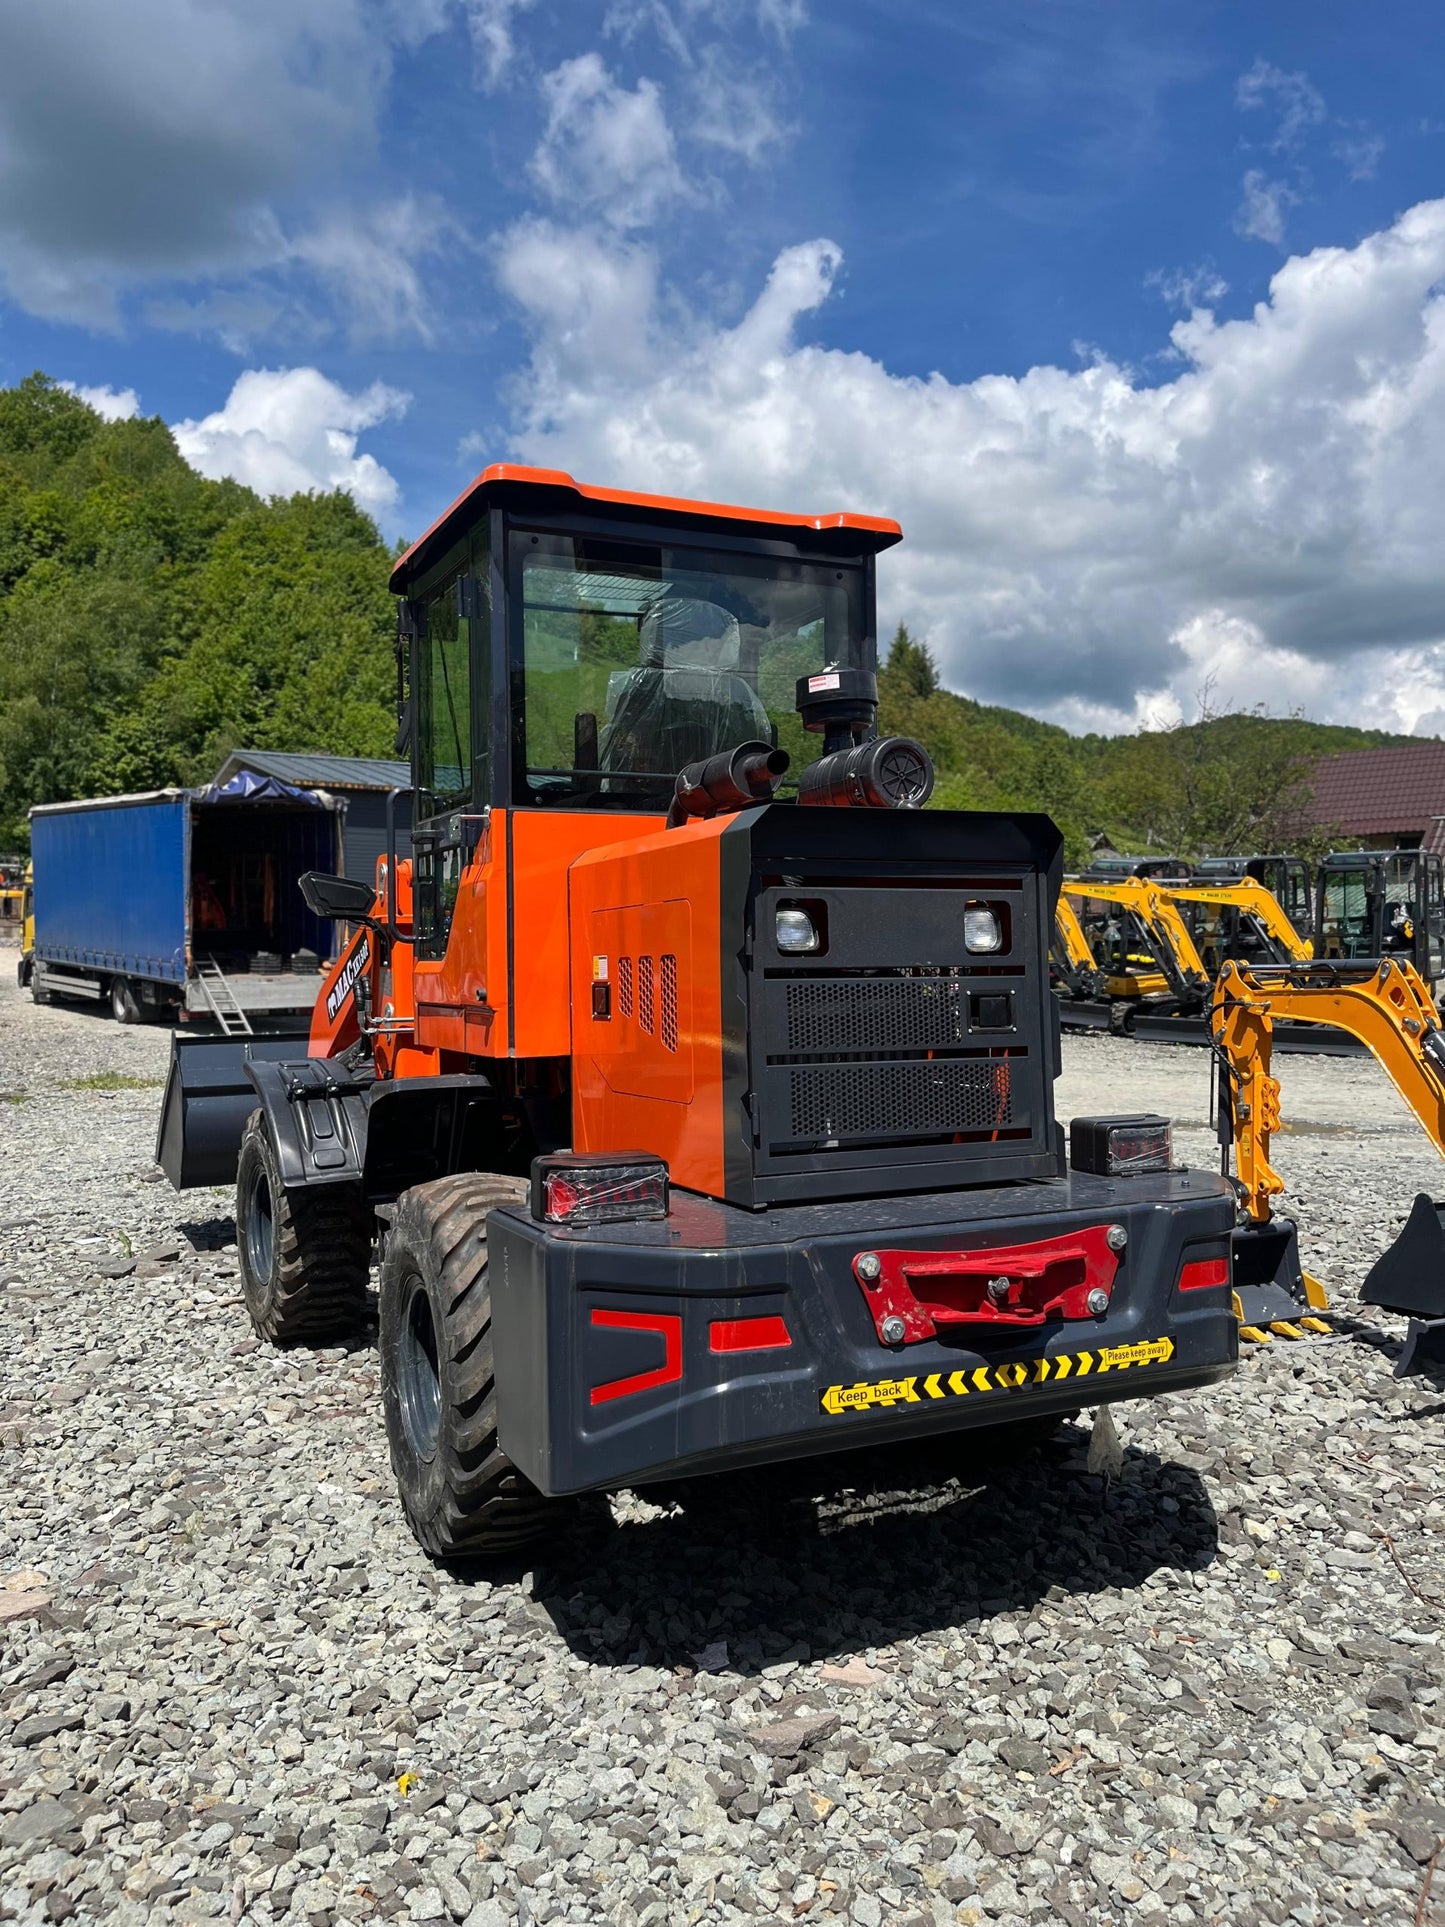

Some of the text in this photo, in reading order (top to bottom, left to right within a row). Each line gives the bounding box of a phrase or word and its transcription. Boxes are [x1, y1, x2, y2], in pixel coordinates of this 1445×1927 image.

[1107, 1346, 1165, 1361] Please keep away
[837, 1383, 902, 1403] Keep back
